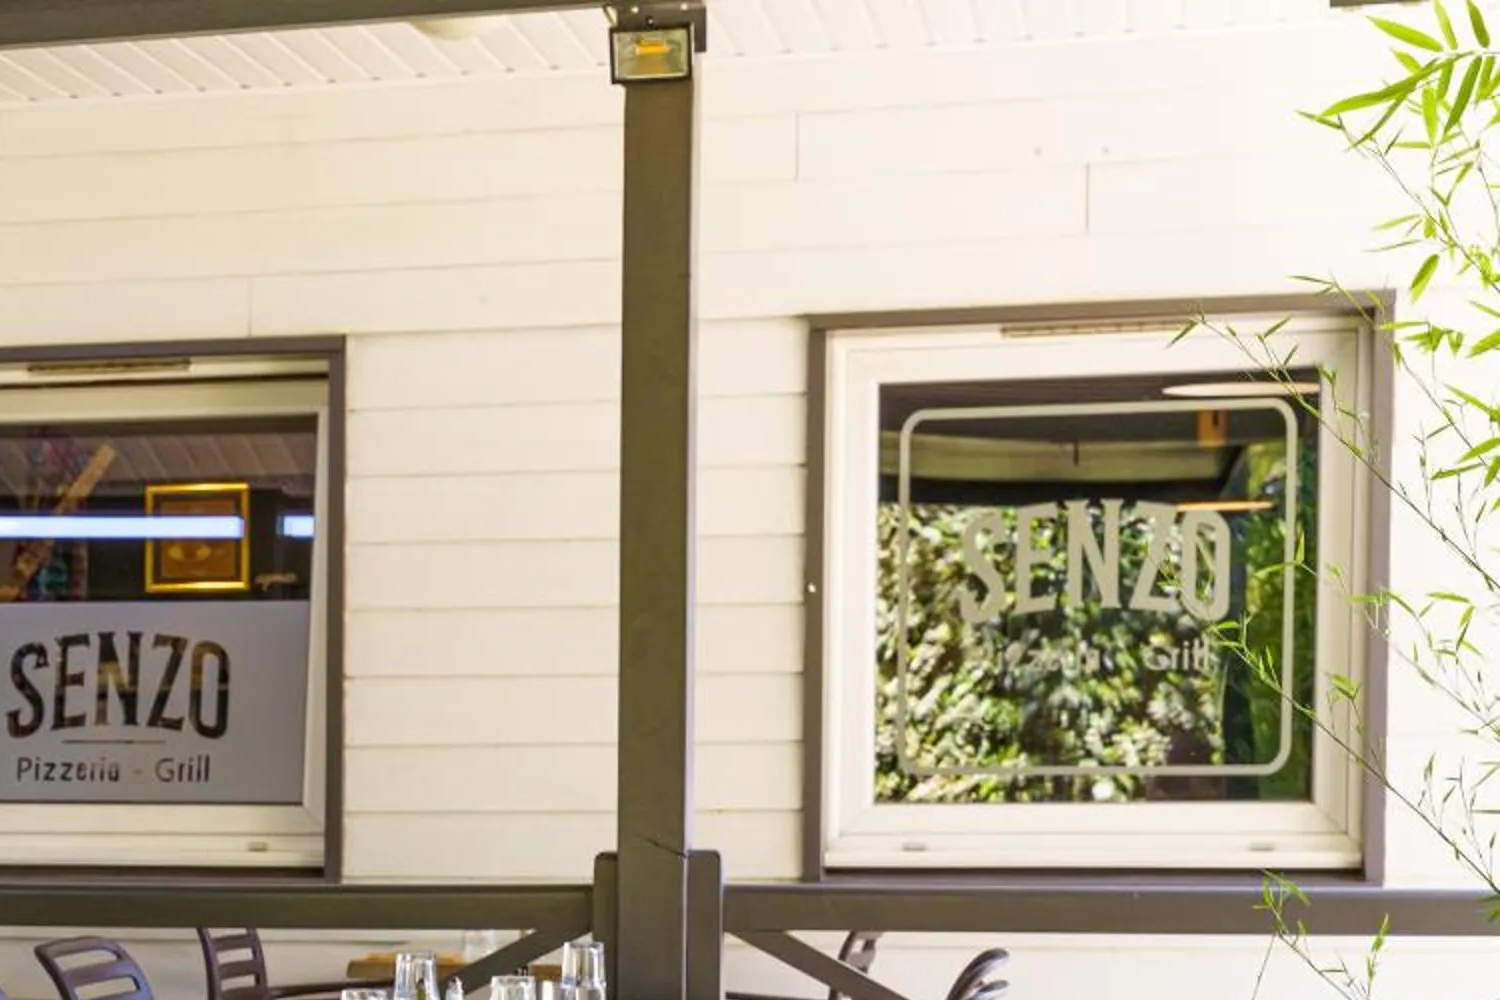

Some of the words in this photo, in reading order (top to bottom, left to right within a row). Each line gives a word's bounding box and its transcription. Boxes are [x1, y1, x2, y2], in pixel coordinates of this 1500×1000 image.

[958, 498, 1232, 625] SENZO
[5, 631, 231, 740] SENZO
[16, 756, 121, 783] Pizzeria
[154, 754, 211, 783] Grill
